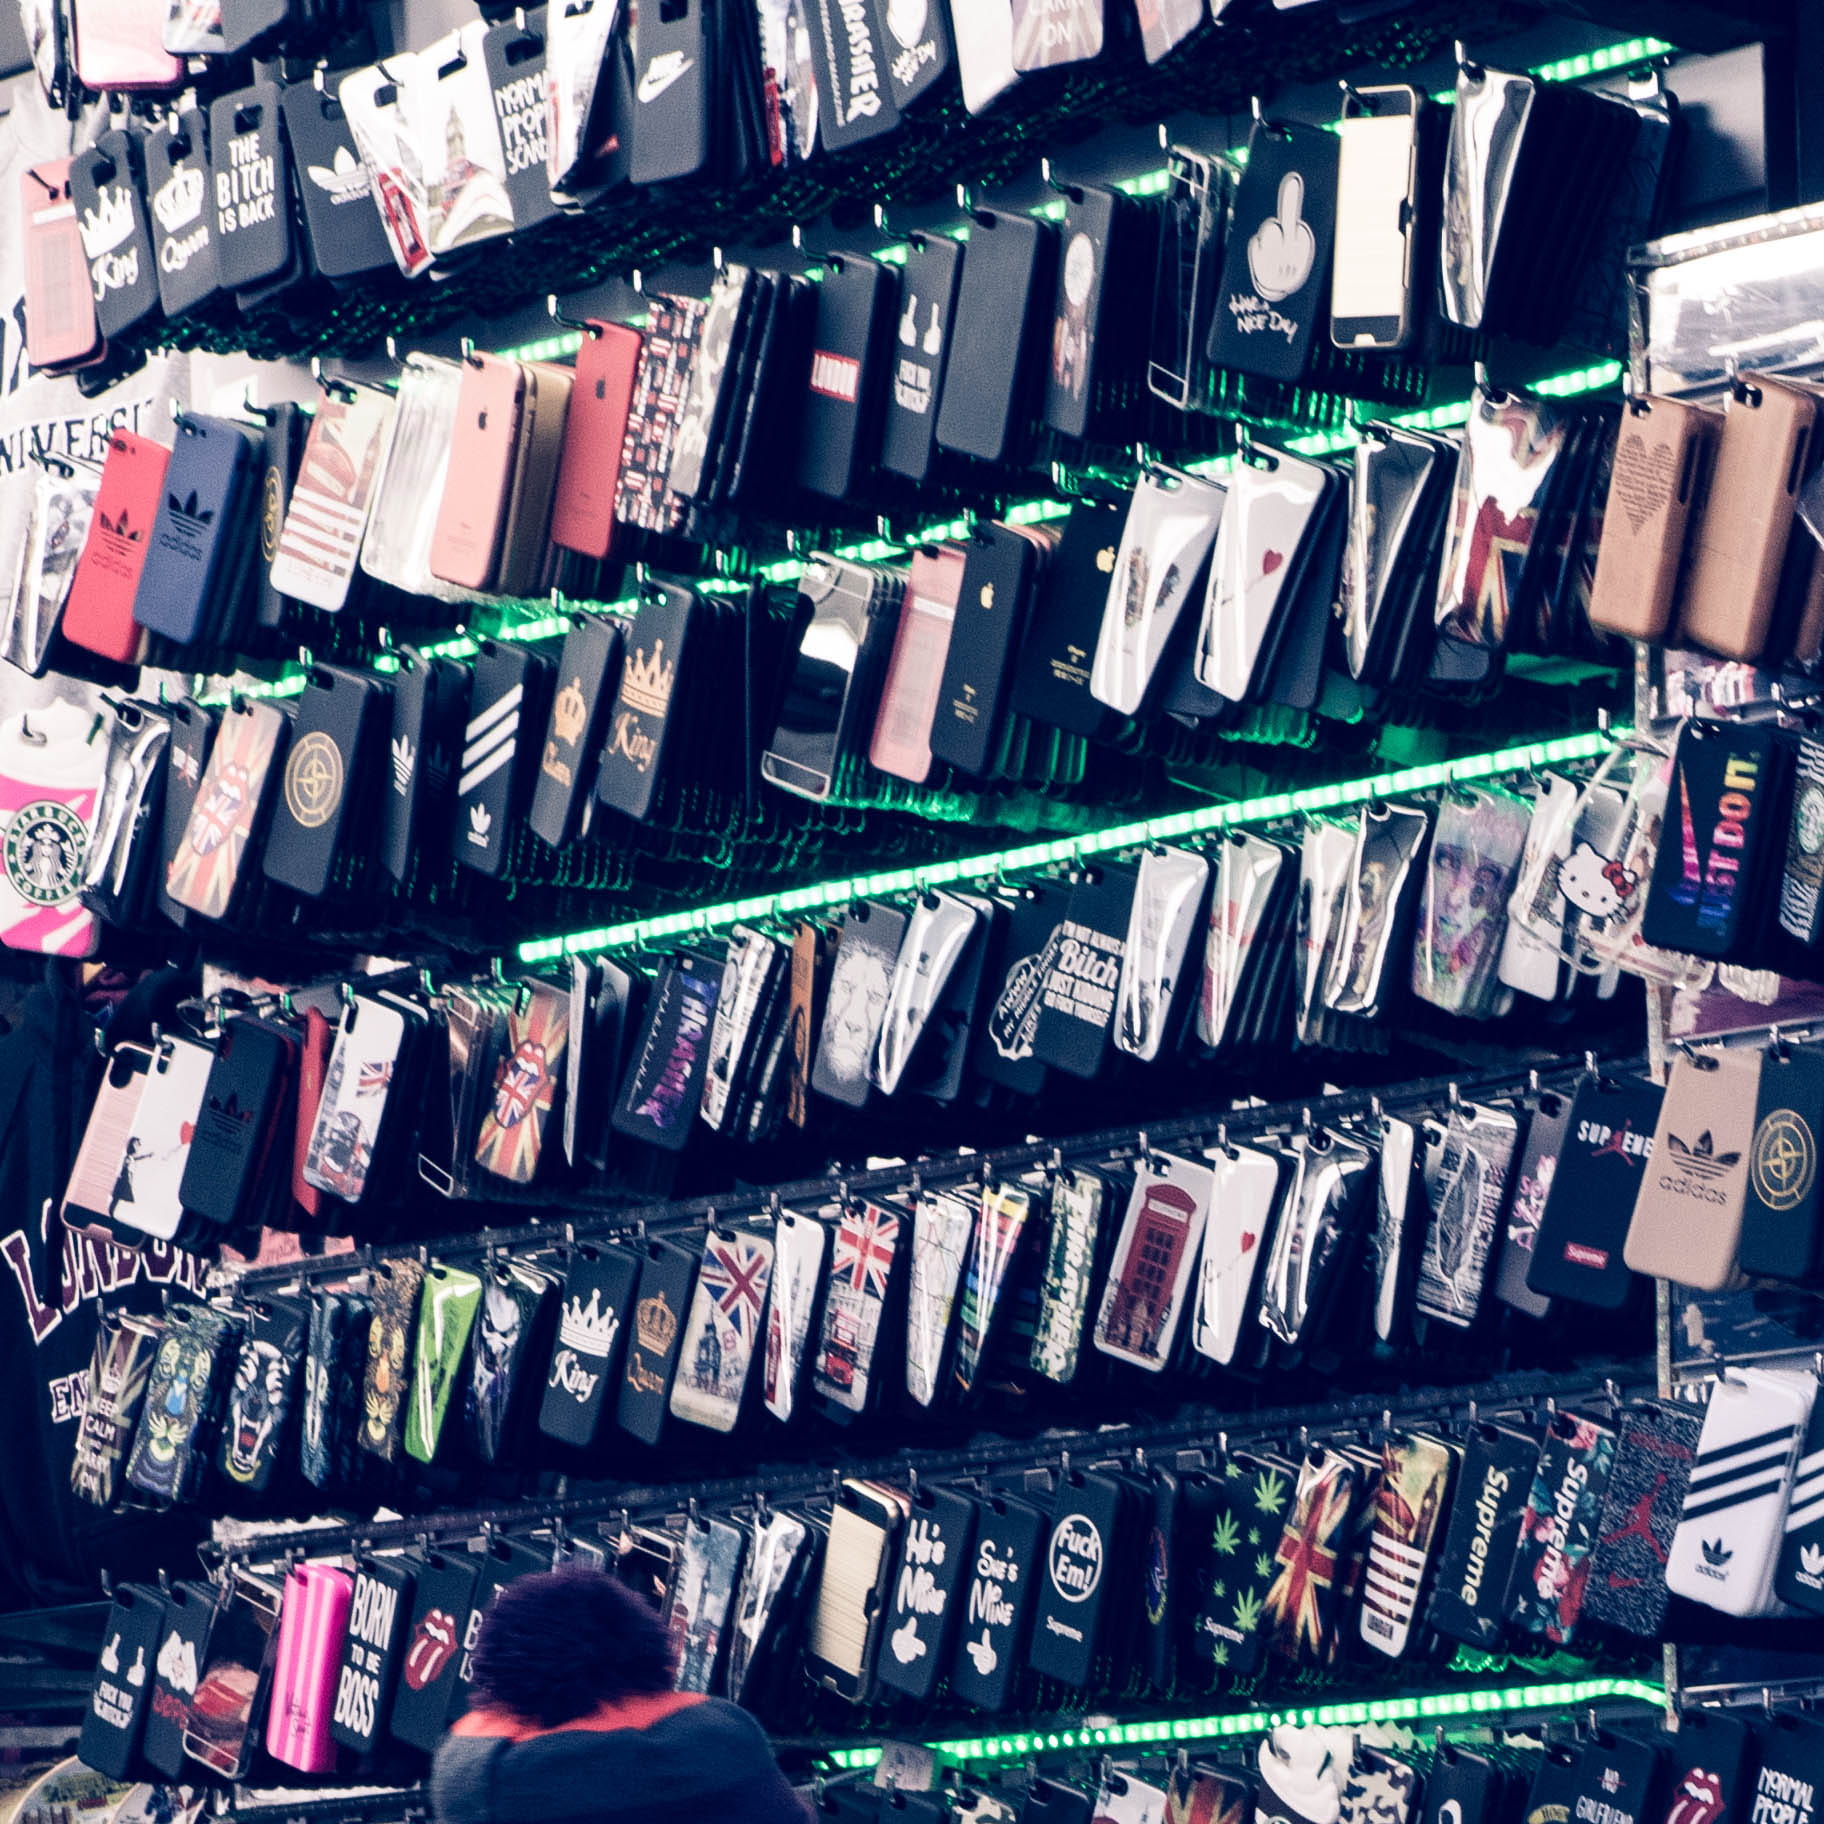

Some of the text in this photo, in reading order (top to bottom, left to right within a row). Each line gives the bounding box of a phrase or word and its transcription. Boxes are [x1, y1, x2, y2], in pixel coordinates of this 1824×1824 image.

[228, 135, 260, 164] THE
[216, 156, 275, 208] BITCH
[219, 195, 275, 234] IS BACK
[91, 247, 139, 301] King
[158, 534, 204, 561] adidas
[605, 714, 657, 774] King
[1059, 936, 1119, 990] Bitch
[1659, 1172, 1729, 1208] adidas
[549, 1350, 600, 1403] King
[626, 1352, 666, 1396] Queen
[1058, 1522, 1100, 1556] Fuck
[1460, 1466, 1509, 1607] Supreme
[1538, 1458, 1588, 1600] Supreme
[1056, 1554, 1093, 1591] Em!
[1695, 1562, 1727, 1583] adidas
[1795, 1570, 1824, 1590] adidas
[351, 1573, 397, 1651] BORN
[1046, 1616, 1083, 1643] Supreme
[1204, 1616, 1245, 1643] Supreme
[335, 1667, 379, 1736] BOSS
[1756, 1766, 1814, 1814] NORMAL
